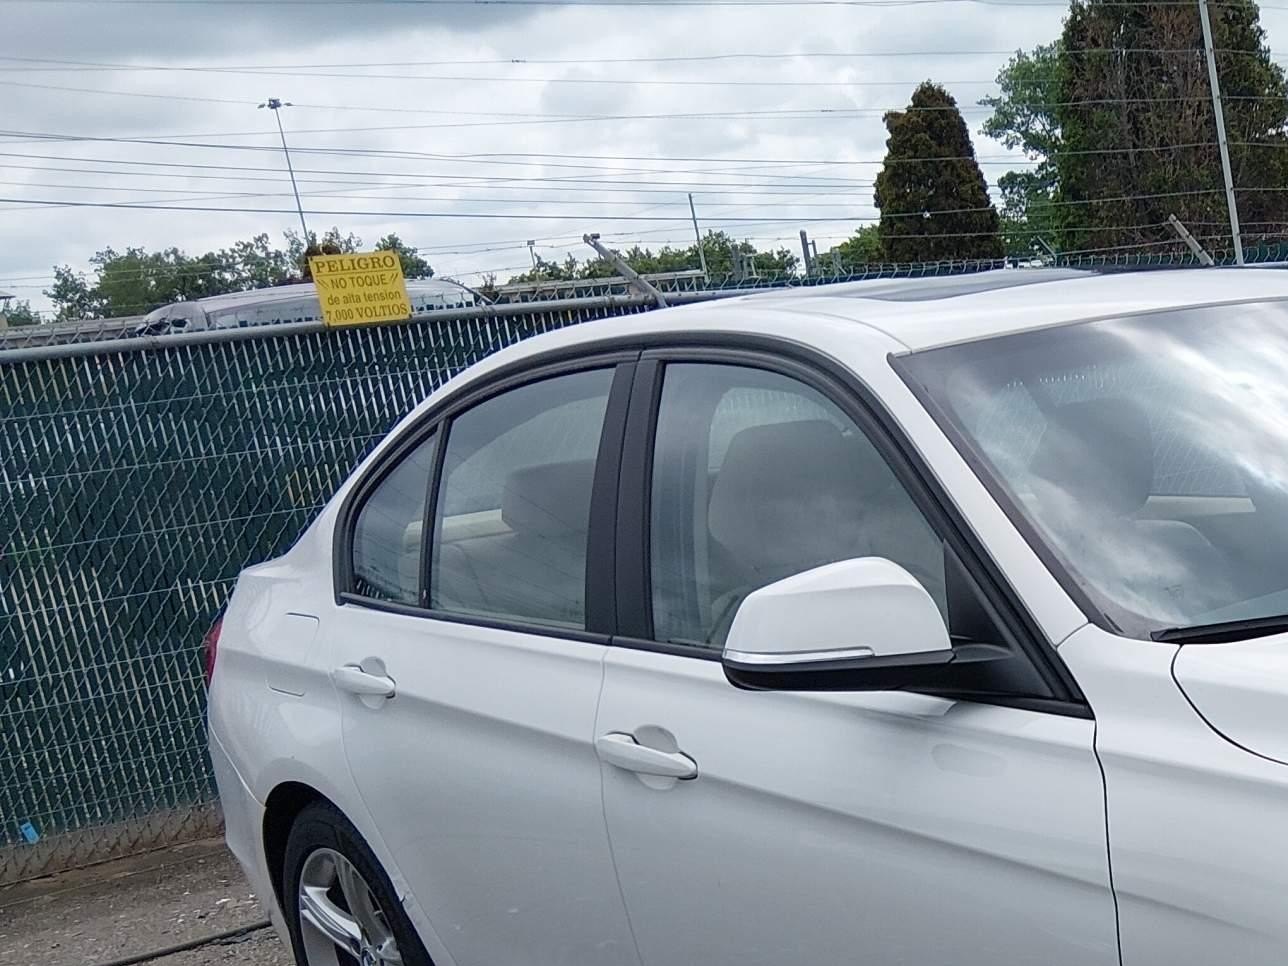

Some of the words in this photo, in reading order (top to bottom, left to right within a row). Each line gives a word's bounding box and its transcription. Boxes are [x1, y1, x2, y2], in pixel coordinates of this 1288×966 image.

[315, 255, 396, 274] PELIGRO
[331, 278, 347, 289] NO
[349, 273, 389, 288] TOQUE
[328, 294, 341, 305] de
[343, 292, 362, 304] alta
[363, 289, 402, 303] tension
[325, 308, 354, 322] 7,000
[356, 303, 408, 319] VOLTIOS
